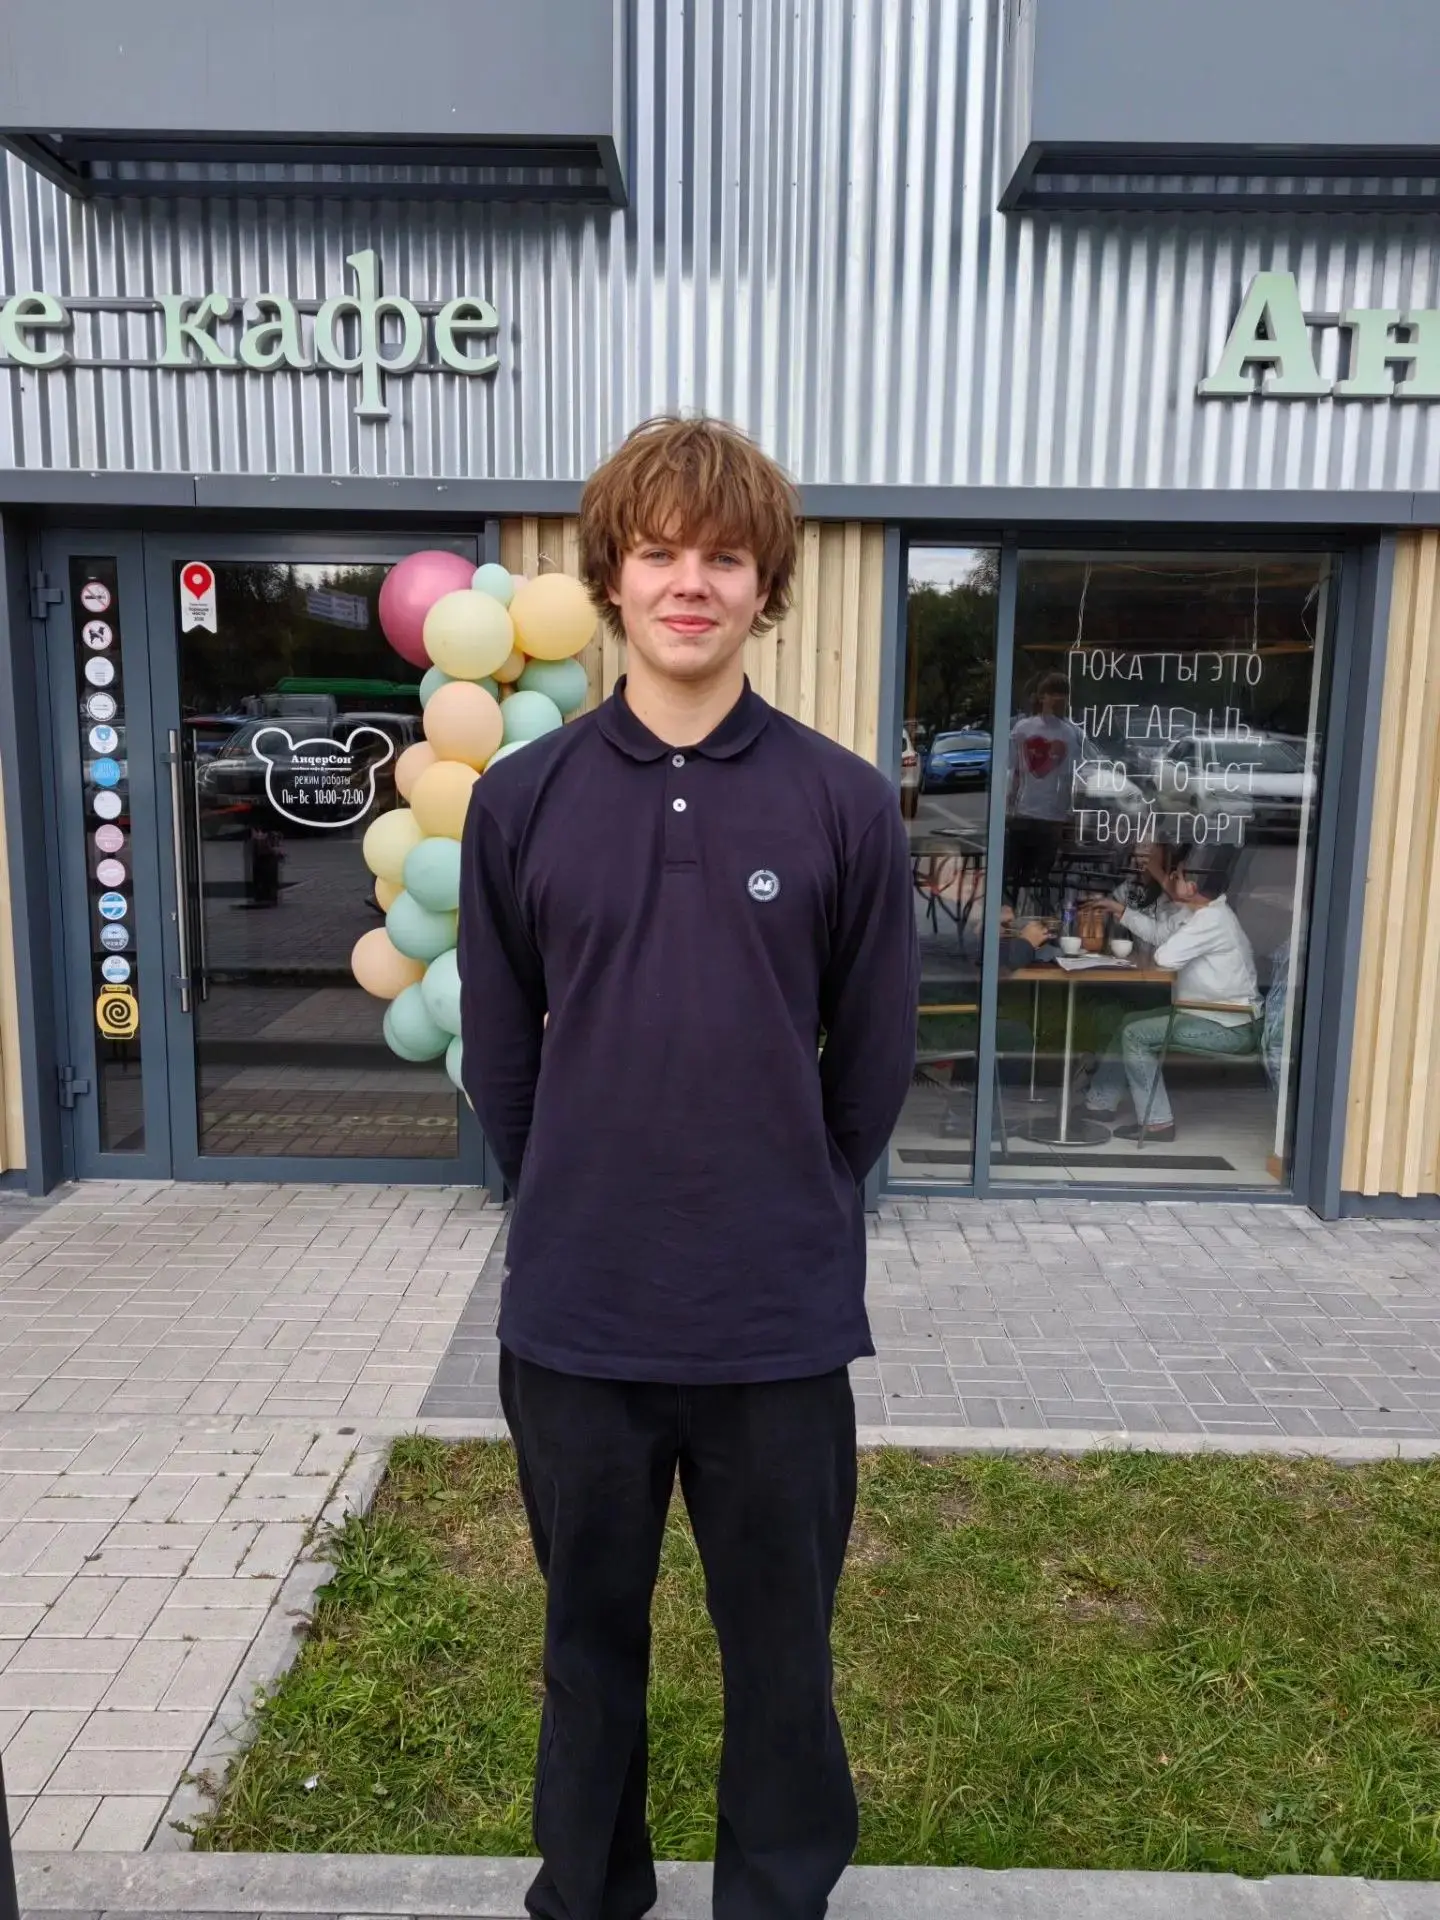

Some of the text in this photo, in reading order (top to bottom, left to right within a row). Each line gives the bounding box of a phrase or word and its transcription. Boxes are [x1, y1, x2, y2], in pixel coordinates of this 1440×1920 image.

[155, 248, 500, 421] кафе
[1198, 271, 1440, 398] Ан
[1069, 650, 1262, 685] ПОКА ТЫ ЭТО
[294, 773, 351, 788] режим работы
[1073, 798, 1252, 844] ТВОЙ ТОРТ
